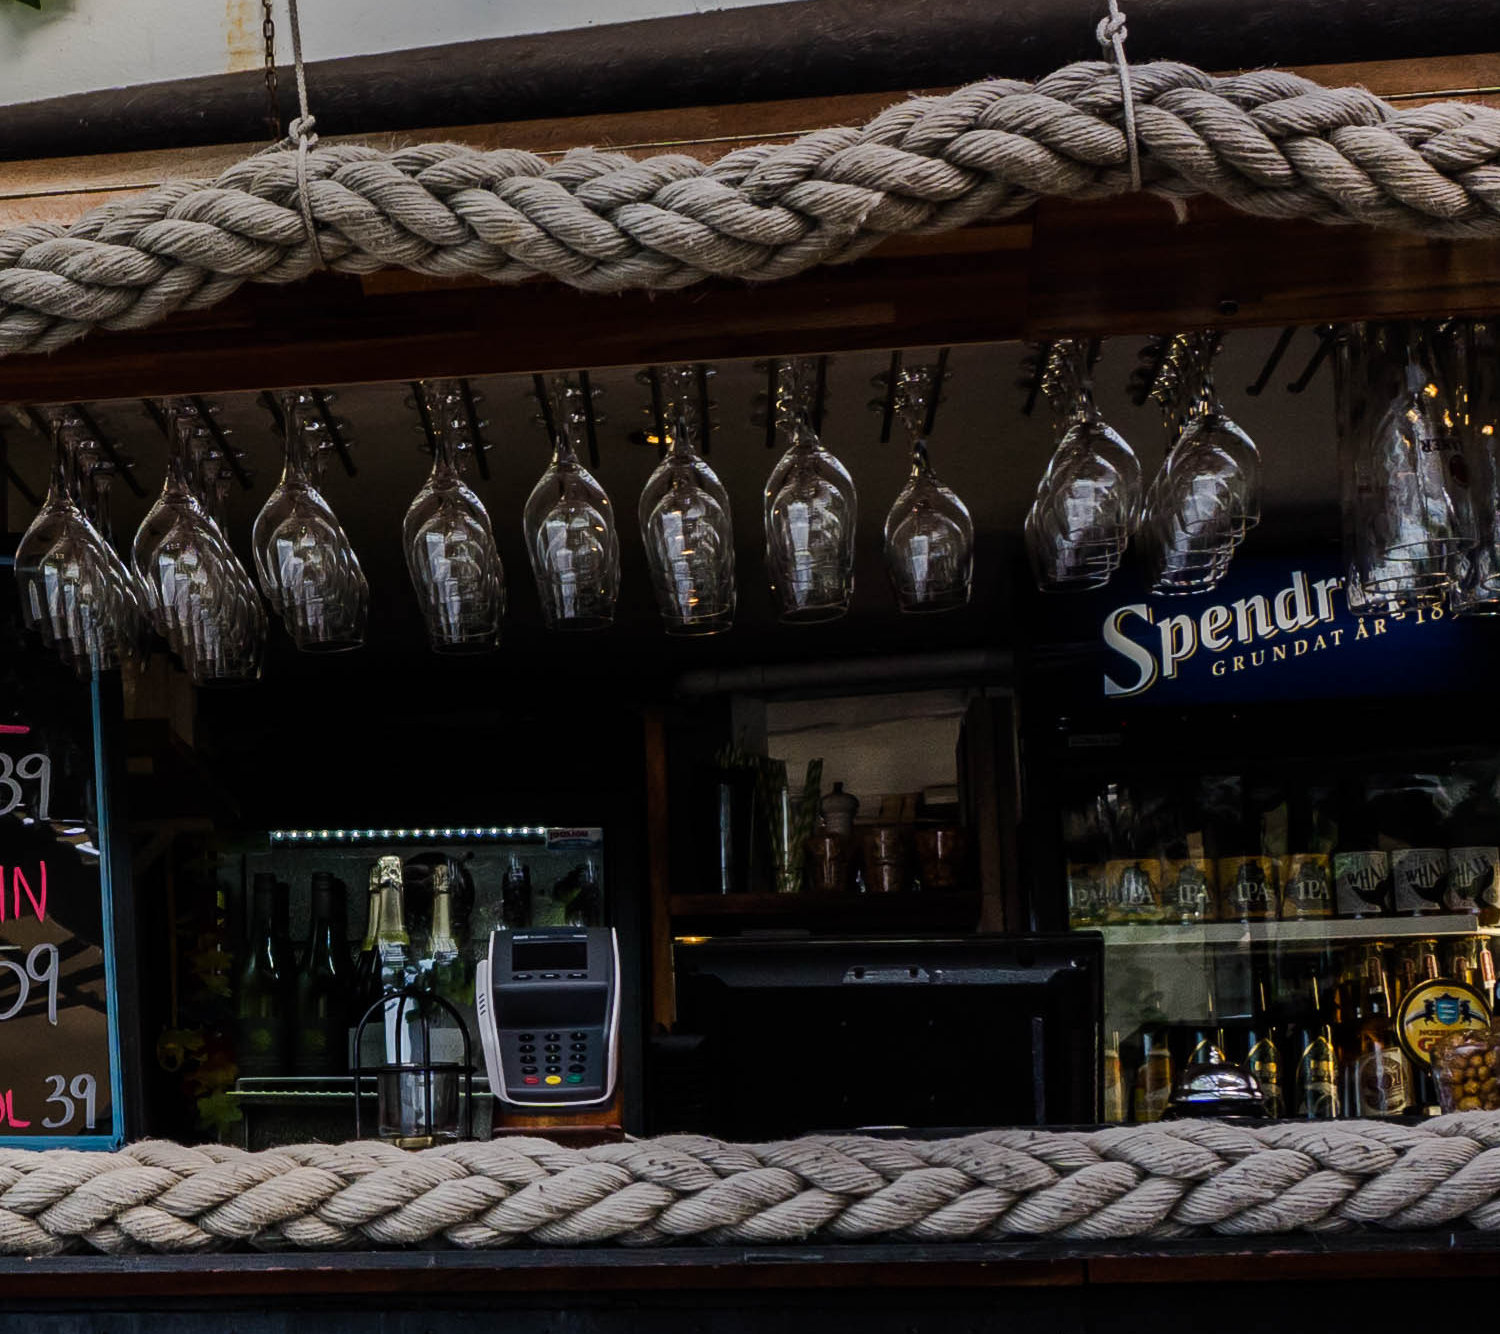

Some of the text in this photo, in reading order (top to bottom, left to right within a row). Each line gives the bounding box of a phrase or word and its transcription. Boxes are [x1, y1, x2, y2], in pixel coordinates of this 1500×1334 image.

[1211, 628, 1345, 677] GRUNDAT
[1355, 617, 1389, 642] ÅR
[1236, 881, 1271, 903] IPA
[1297, 880, 1330, 901] IPA
[40, 1073, 97, 1130] 39
